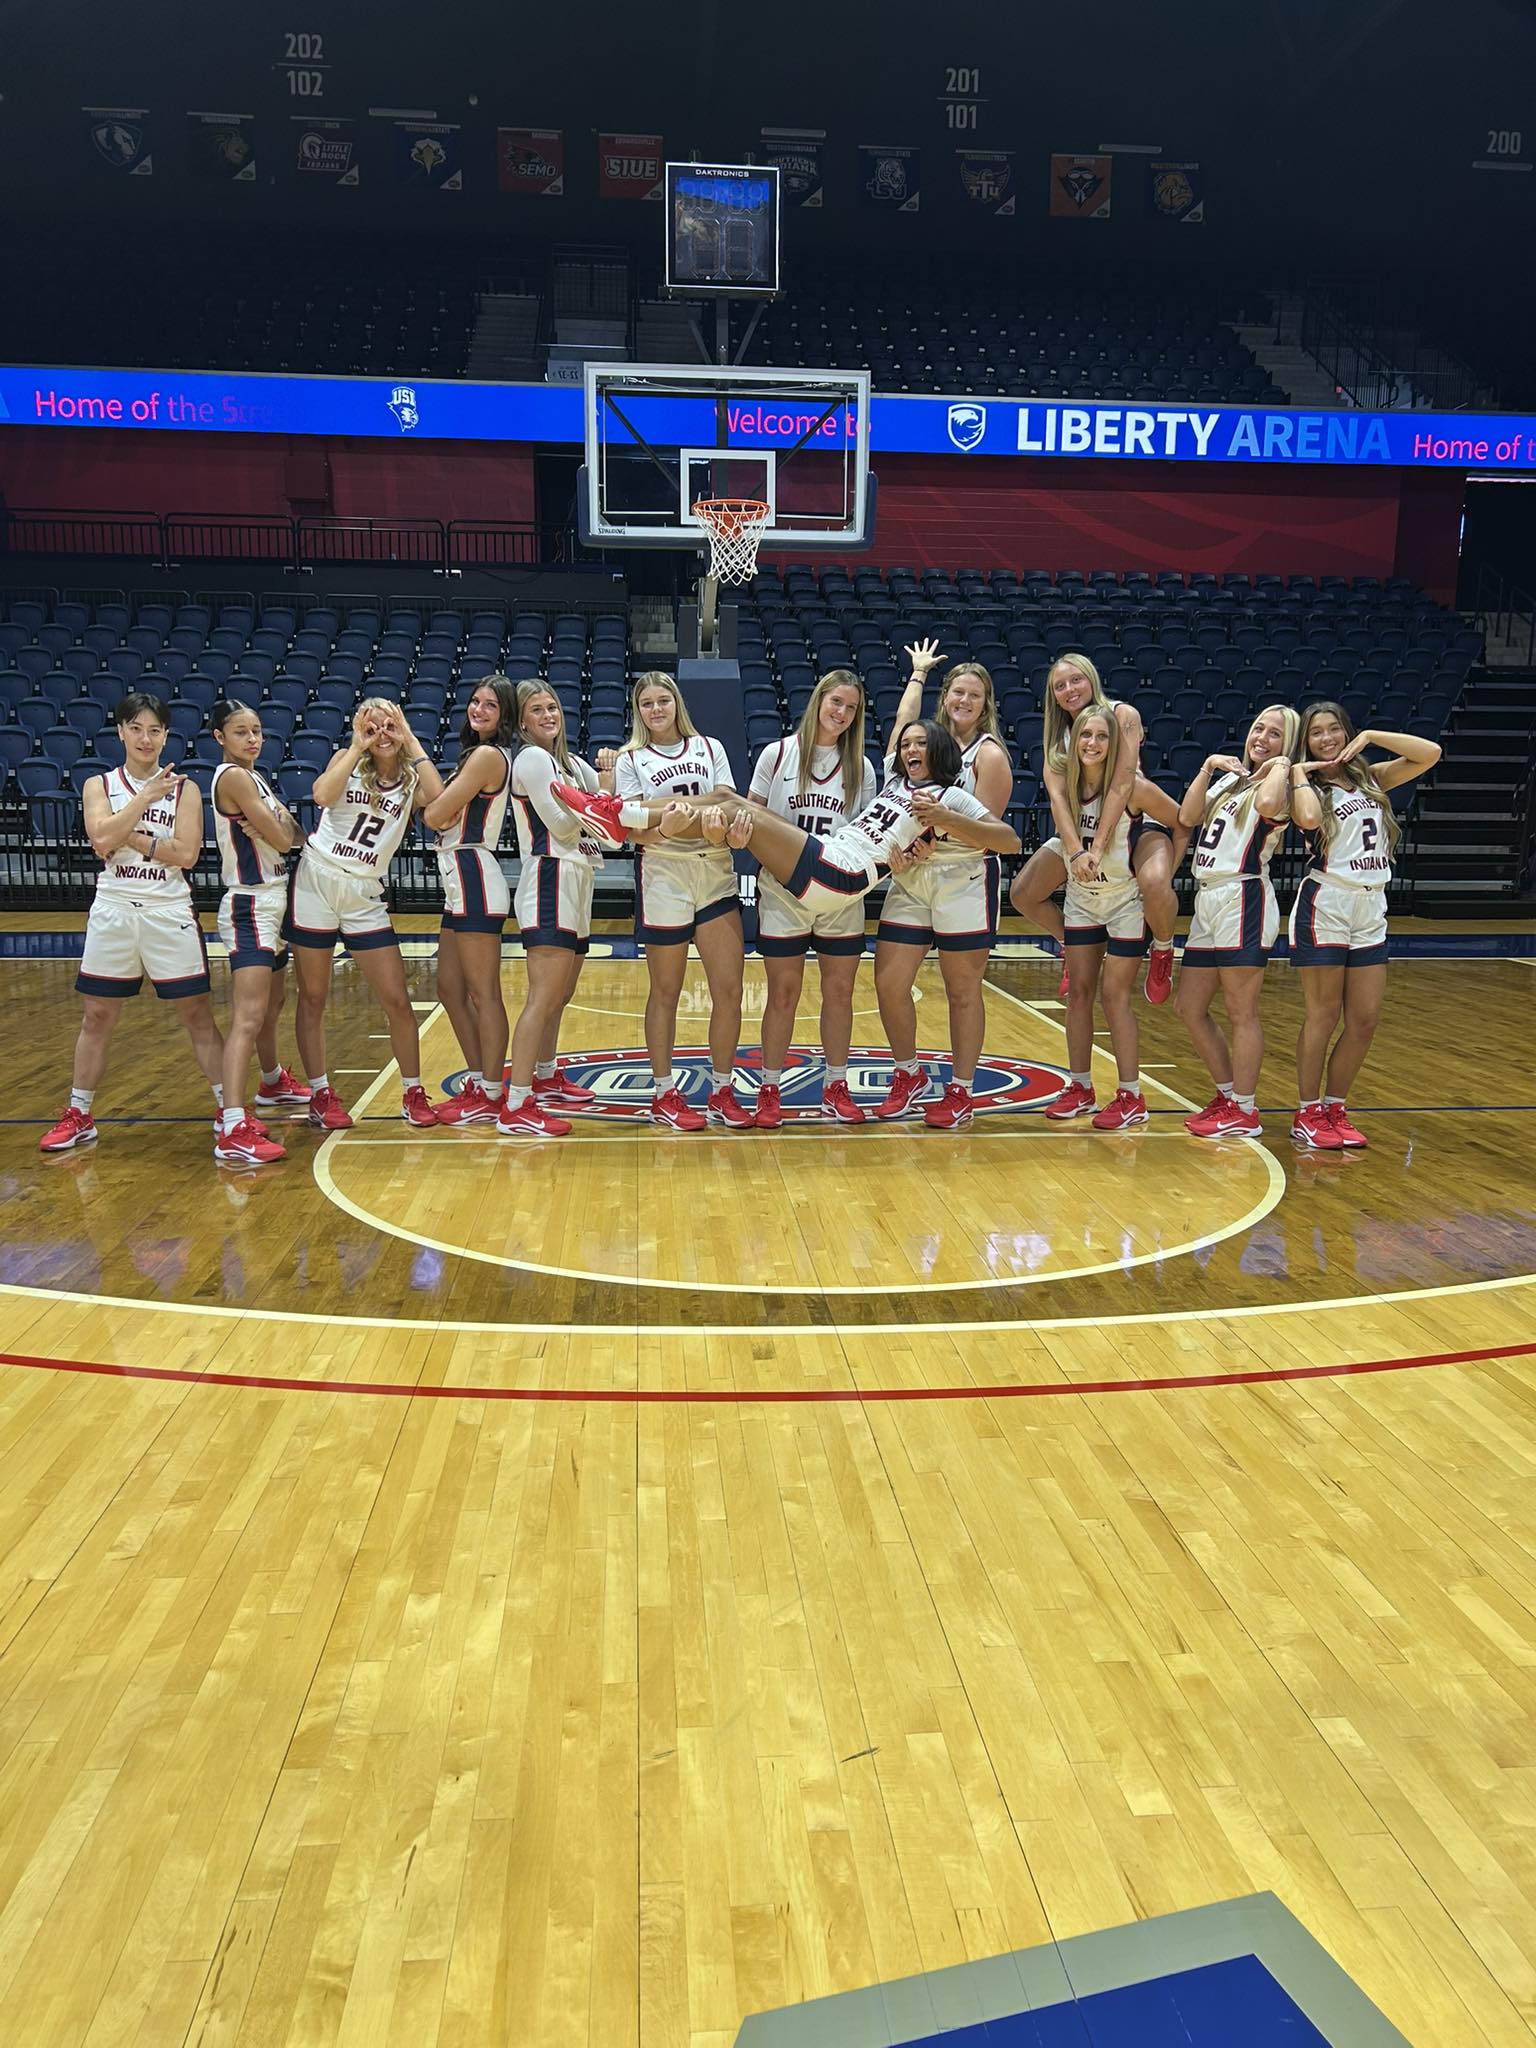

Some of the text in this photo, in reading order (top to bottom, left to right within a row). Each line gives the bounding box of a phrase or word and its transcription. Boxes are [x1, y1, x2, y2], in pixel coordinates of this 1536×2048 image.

[285, 33, 323, 59] 202
[287, 71, 323, 96] 102
[946, 68, 979, 93] 201
[946, 105, 977, 129] 101
[321, 144, 349, 153] LITTLE
[1487, 131, 1521, 154] 200
[320, 152, 347, 160] ROCK
[607, 158, 658, 178] SIUE
[518, 163, 557, 178] SEMO
[695, 169, 750, 178] DAKTRONICS
[35, 390, 123, 420] Home
[131, 393, 160, 420] of
[168, 395, 214, 423] the
[392, 389, 416, 406] USI
[1017, 408, 1392, 460] LIBERTY ARENA
[1413, 433, 1489, 460] Home
[1495, 434, 1523, 461] of
[598, 527, 626, 535] SPALDING
[650, 762, 709, 787] SOUTHERN
[346, 790, 403, 821] SOUHERN
[788, 793, 846, 815] SOUTHERN
[348, 812, 385, 848] 12
[861, 803, 901, 833] 24
[1362, 818, 1378, 851] 2
[331, 842, 379, 867] INDIANA
[1349, 856, 1388, 871] INDIANA
[115, 864, 167, 881] INDIANA
